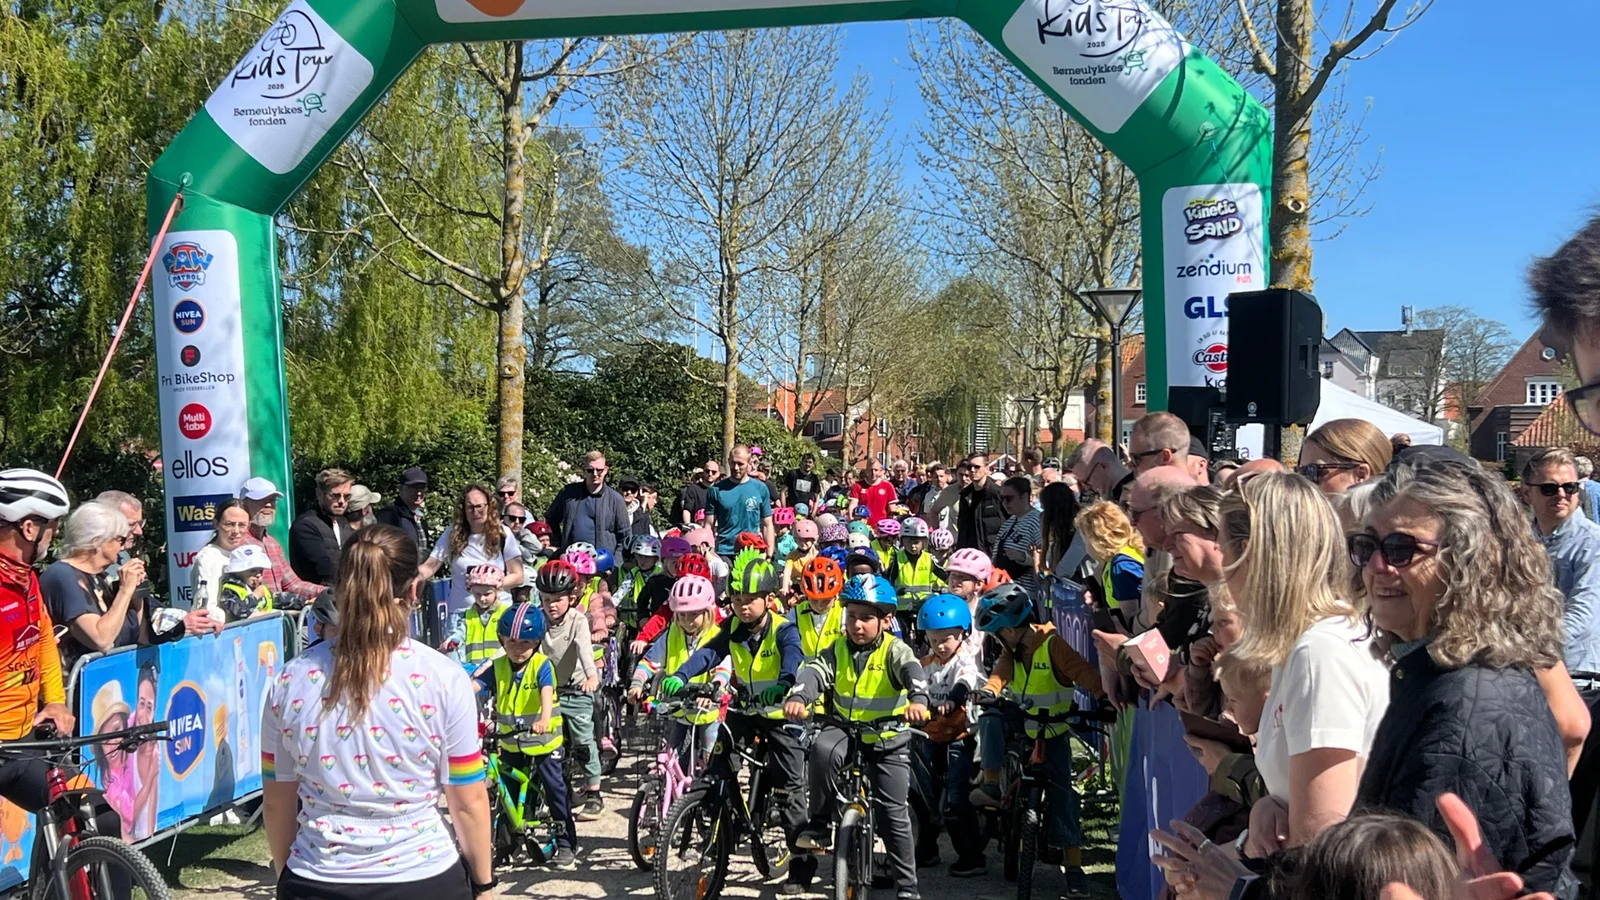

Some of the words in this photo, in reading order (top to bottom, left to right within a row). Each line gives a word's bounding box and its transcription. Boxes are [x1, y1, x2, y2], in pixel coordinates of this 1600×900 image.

[1037, 5, 1107, 44] Kids
[231, 49, 286, 88] Kids
[284, 46, 334, 84] Tour
[1070, 77, 1106, 85] fonden
[249, 117, 287, 127] fonden
[1185, 200, 1237, 220] Kinetic
[162, 250, 214, 272] PAW
[1176, 260, 1252, 278] zendium
[172, 274, 201, 283] PATROL
[175, 310, 201, 319] NIVEA
[1184, 296, 1229, 319] GL
[180, 319, 196, 327] SUN
[1194, 350, 1228, 363] Cast
[161, 375, 172, 386] Fri
[175, 372, 235, 385] BikeShop
[183, 413, 205, 422] Multi
[172, 450, 229, 479] ellos
[177, 504, 216, 521] Was
[169, 713, 203, 738] NIVEA
